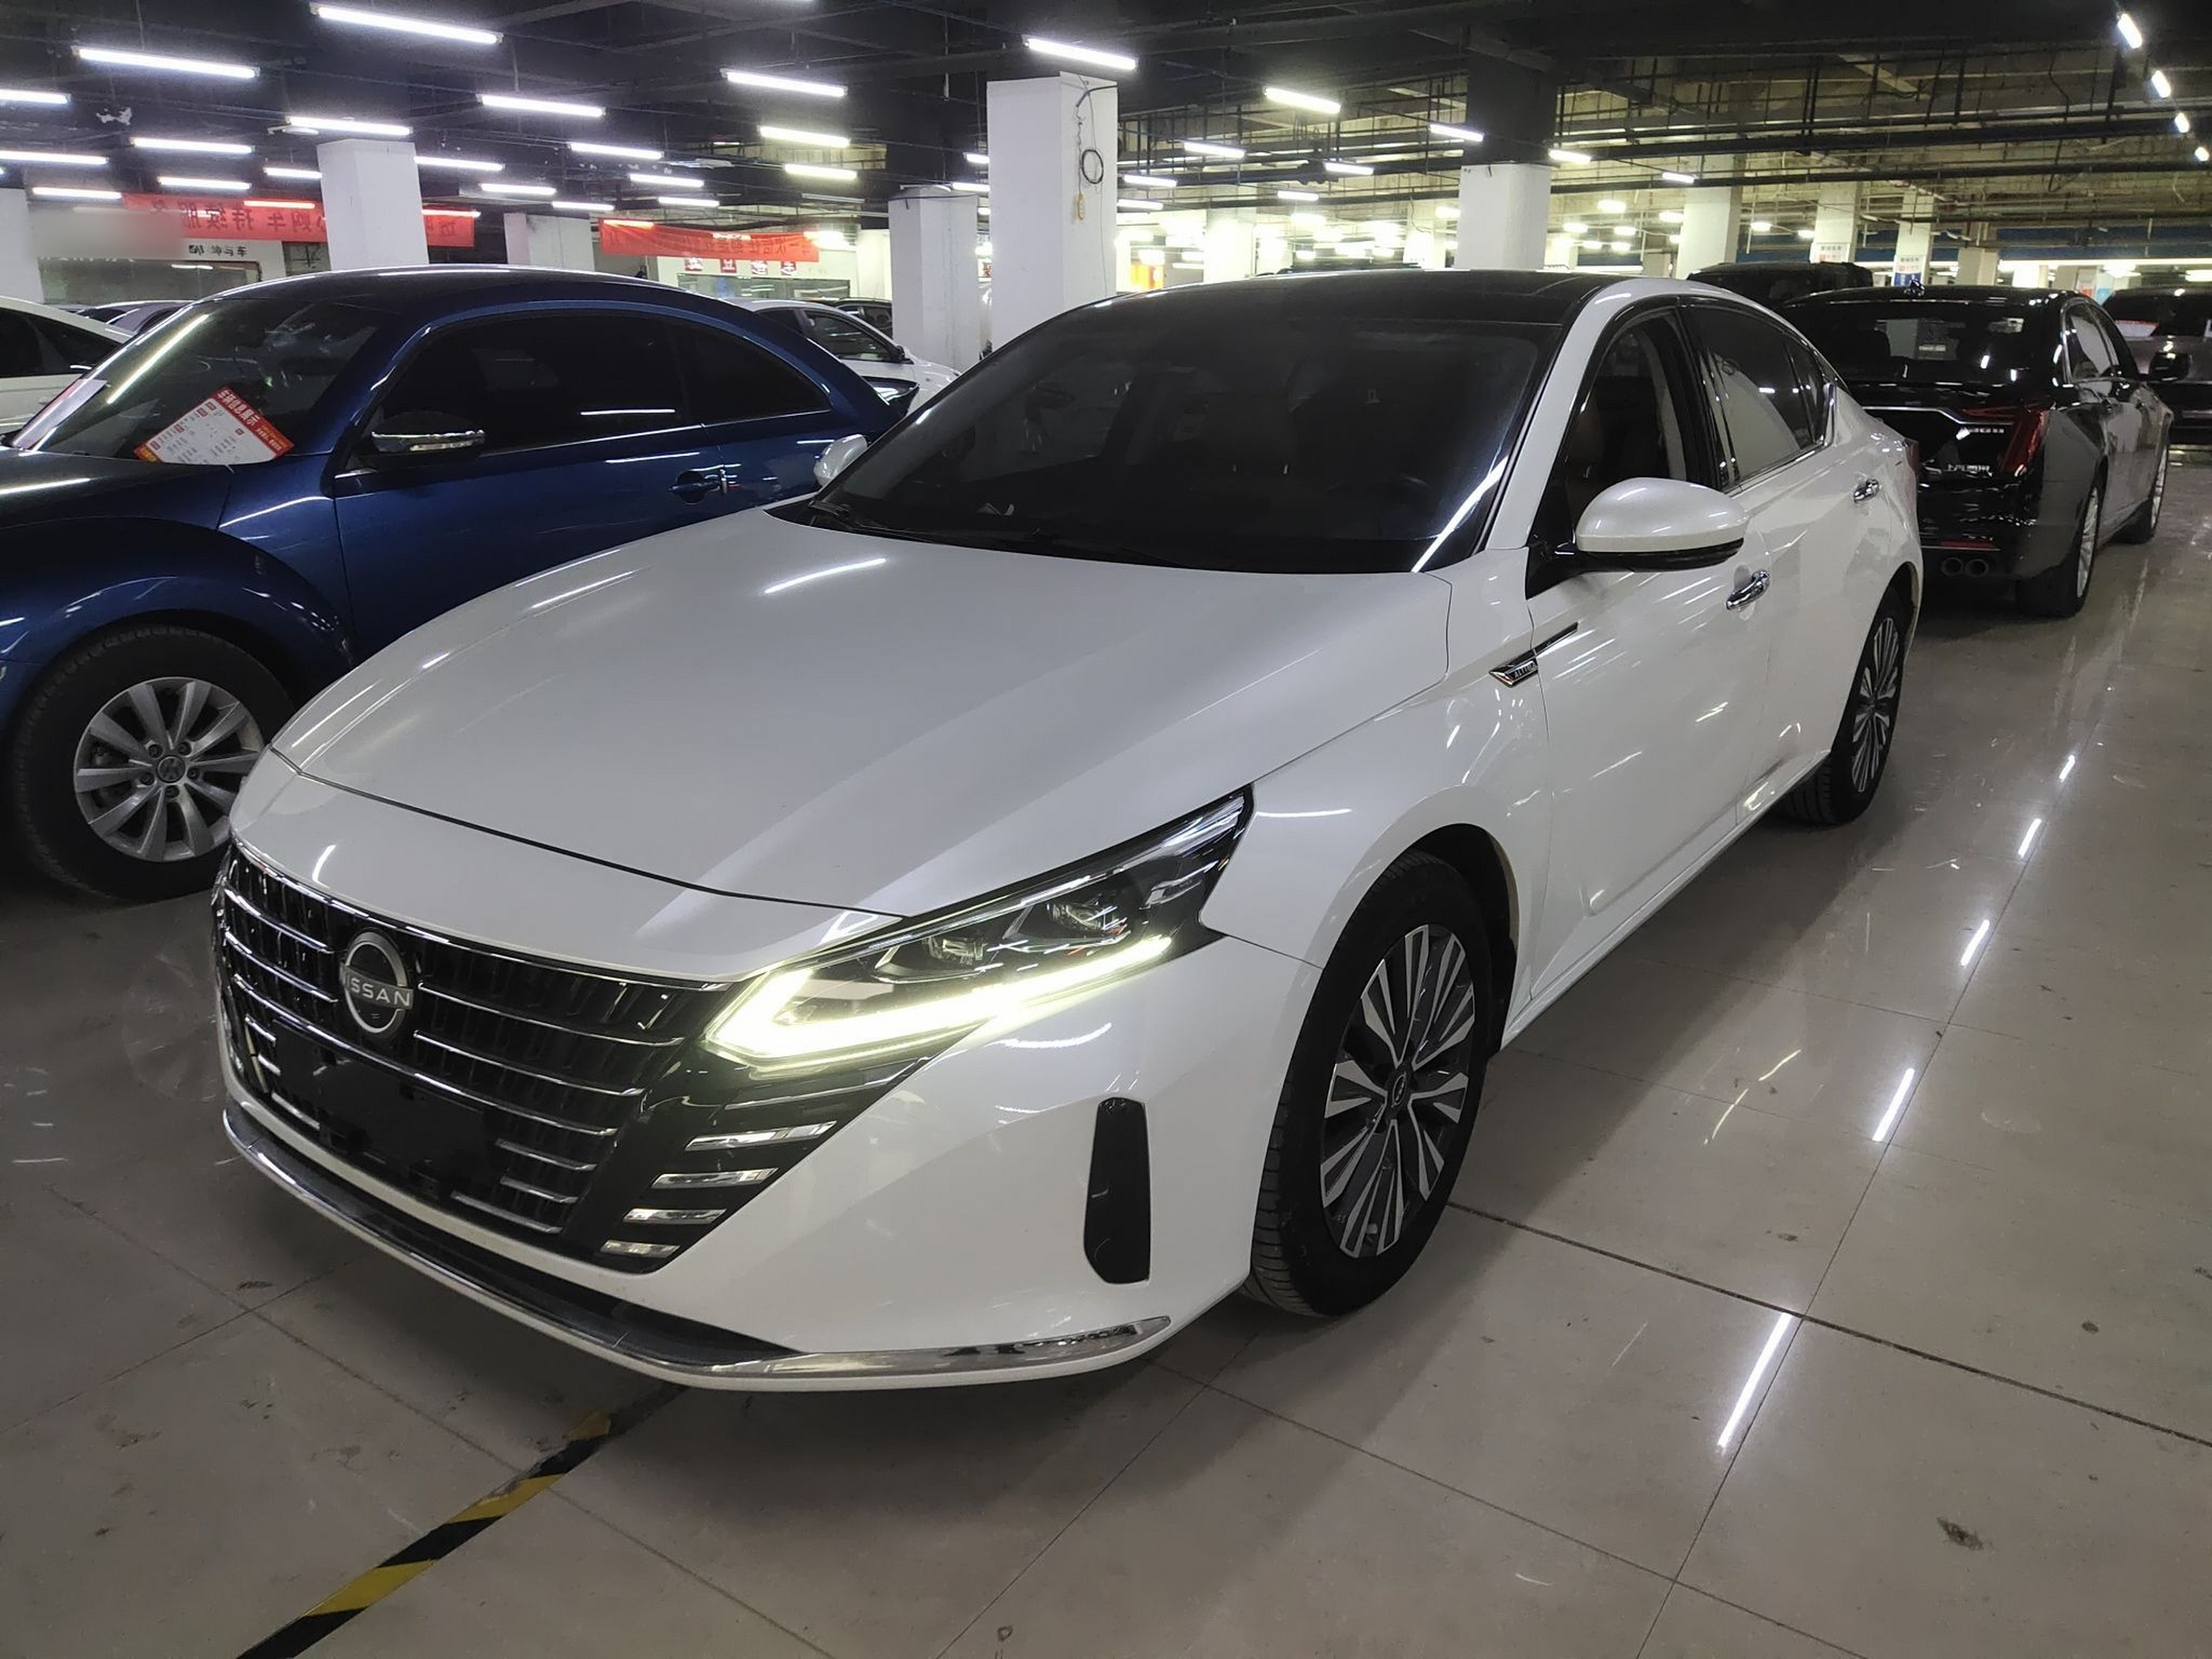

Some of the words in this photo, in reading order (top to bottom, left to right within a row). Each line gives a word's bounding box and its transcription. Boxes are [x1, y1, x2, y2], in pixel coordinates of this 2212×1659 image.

[217, 390, 260, 426] 车辆信息展示
